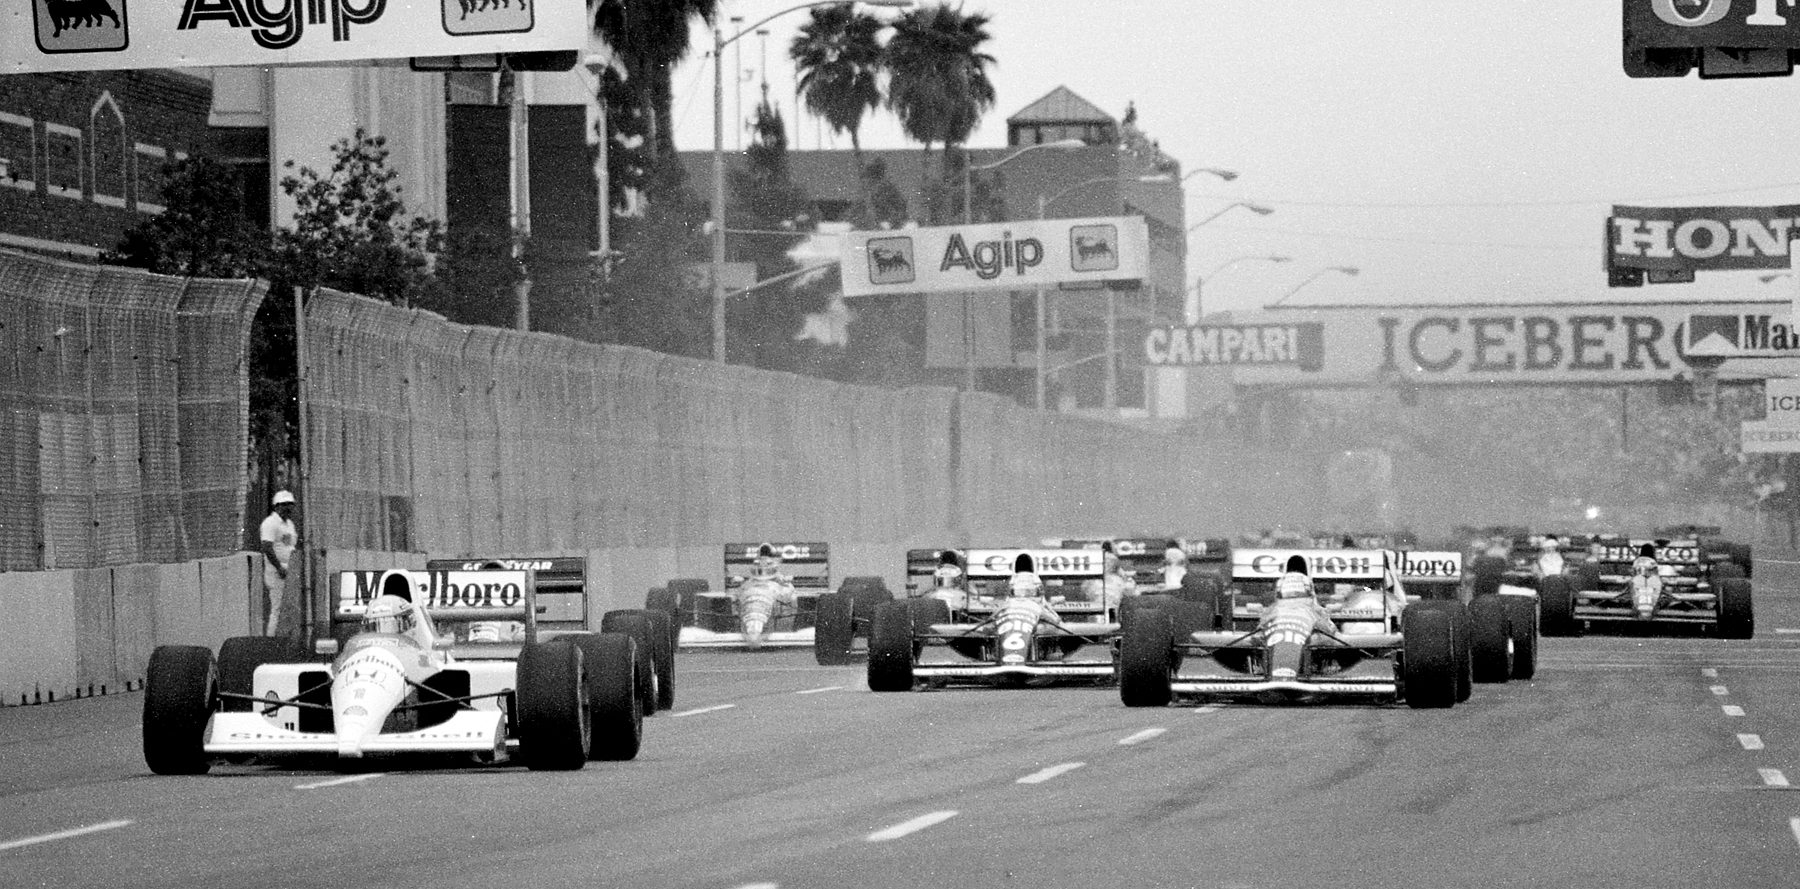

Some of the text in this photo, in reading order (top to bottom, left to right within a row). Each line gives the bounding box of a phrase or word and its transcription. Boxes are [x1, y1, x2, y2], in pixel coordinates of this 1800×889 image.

[1614, 218, 1800, 258] HON
[940, 231, 1044, 280] Agip
[1145, 327, 1298, 365] CAMPARI
[984, 555, 1091, 571] Cnon
[1252, 556, 1370, 574] Cnon
[1395, 550, 1456, 576] lboro
[1606, 547, 1693, 561] FINCO
[462, 561, 553, 572] GYEAR
[354, 571, 521, 607] Mlboro
[1003, 632, 1026, 650] 6
